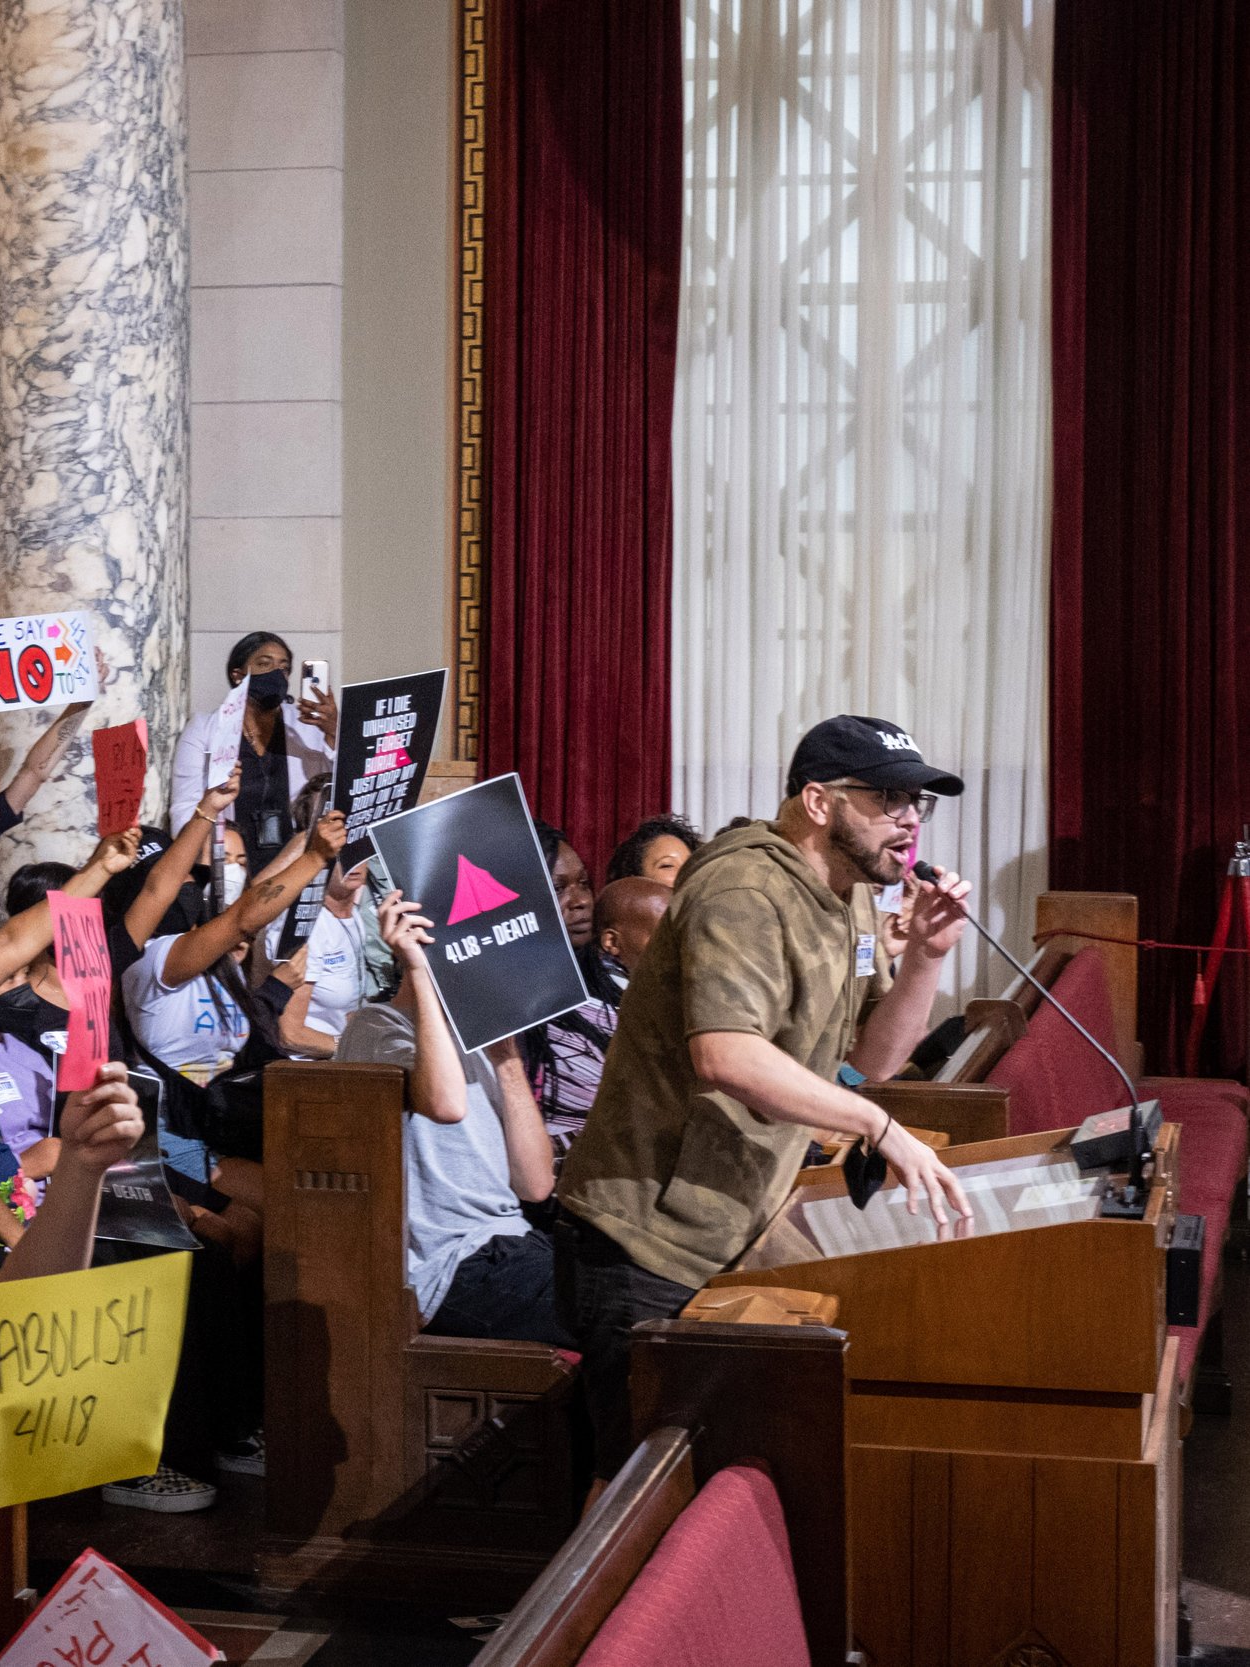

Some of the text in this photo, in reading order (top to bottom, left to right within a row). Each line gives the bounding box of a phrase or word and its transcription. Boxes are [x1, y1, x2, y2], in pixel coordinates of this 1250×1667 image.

[14, 619, 45, 641] SAY
[54, 672, 75, 694] TO
[375, 699, 387, 716] IF
[394, 694, 412, 713] DIE
[362, 712, 417, 737] UNHOUSED
[376, 731, 414, 753] FORGET
[365, 752, 399, 774] BURIAL
[349, 776, 376, 796] JUST
[375, 768, 401, 790] DROP
[351, 792, 377, 813] BODY
[376, 788, 391, 804] ON
[391, 781, 410, 799] THE
[346, 808, 375, 830] STEPS
[373, 802, 388, 819] OF
[445, 935, 481, 963] 41.18
[492, 912, 539, 945] DEATH
[112, 1184, 153, 1201] DEATH
[14, 1395, 98, 1456] 41.18
